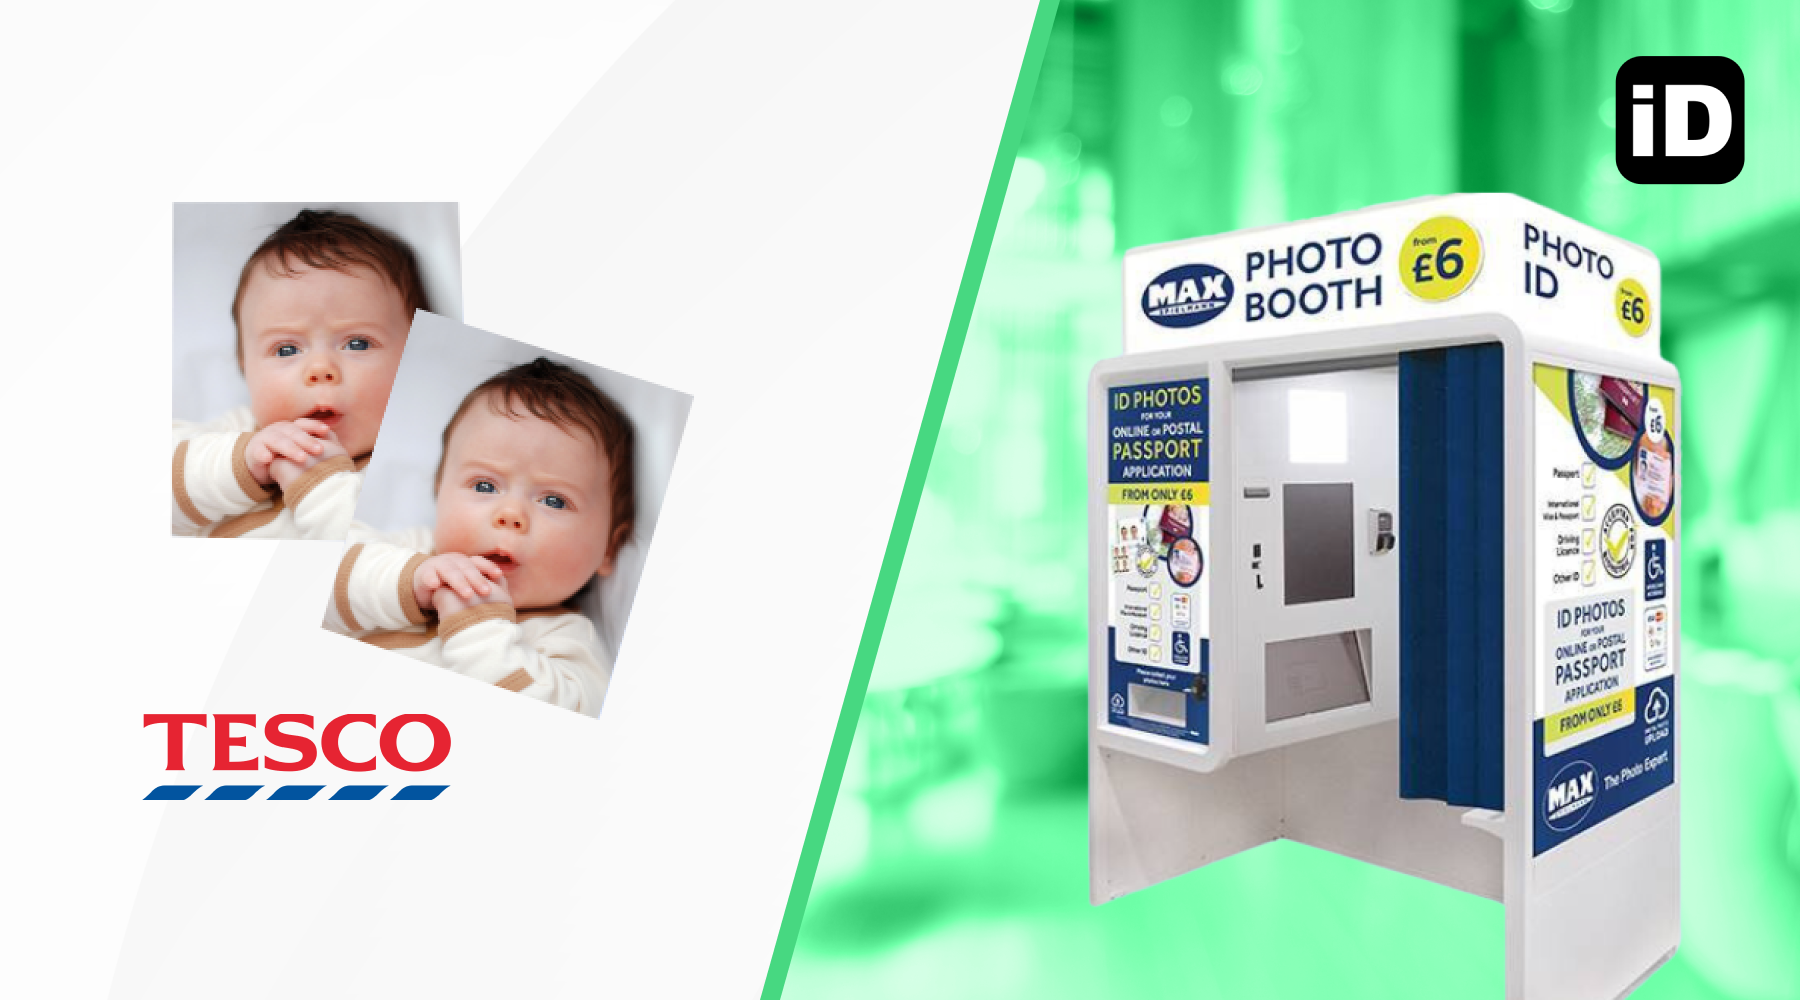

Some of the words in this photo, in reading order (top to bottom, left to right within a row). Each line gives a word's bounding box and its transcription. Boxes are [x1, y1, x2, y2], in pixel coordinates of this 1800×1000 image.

[1413, 236, 1437, 248] from
[1524, 222, 1614, 279] PHOTO
[1246, 232, 1382, 282] PHOTO
[1412, 238, 1464, 283] £6
[1148, 273, 1227, 308] MAX
[1525, 261, 1559, 299] ID
[1246, 275, 1382, 322] BOOTH
[1621, 297, 1644, 324] £6
[1114, 392, 1130, 410] ID
[1133, 385, 1202, 409] PHOTOS
[1113, 425, 1150, 438] ONLINE
[1163, 422, 1203, 435] POSTAL
[1113, 439, 1203, 460] PASSPORT
[1123, 464, 1192, 478] APPLICATION
[1552, 468, 1580, 480] Passport
[1123, 489, 1149, 500] FROM
[1151, 489, 1178, 500] ONLY
[1557, 534, 1580, 545] Driving
[1557, 608, 1572, 629] ID
[1574, 598, 1626, 626] PHOTOS
[1556, 641, 1588, 661] ONLINE
[1597, 633, 1626, 649] POSTAL
[1556, 648, 1626, 686] PASSPORT
[1564, 675, 1620, 703] APPLICATION
[1560, 713, 1587, 733] FROM
[1588, 703, 1612, 726] ONLY
[1604, 775, 1620, 790] The
[1621, 763, 1644, 782] Photo
[1644, 751, 1669, 771] Expert
[1548, 771, 1594, 813] MAX
